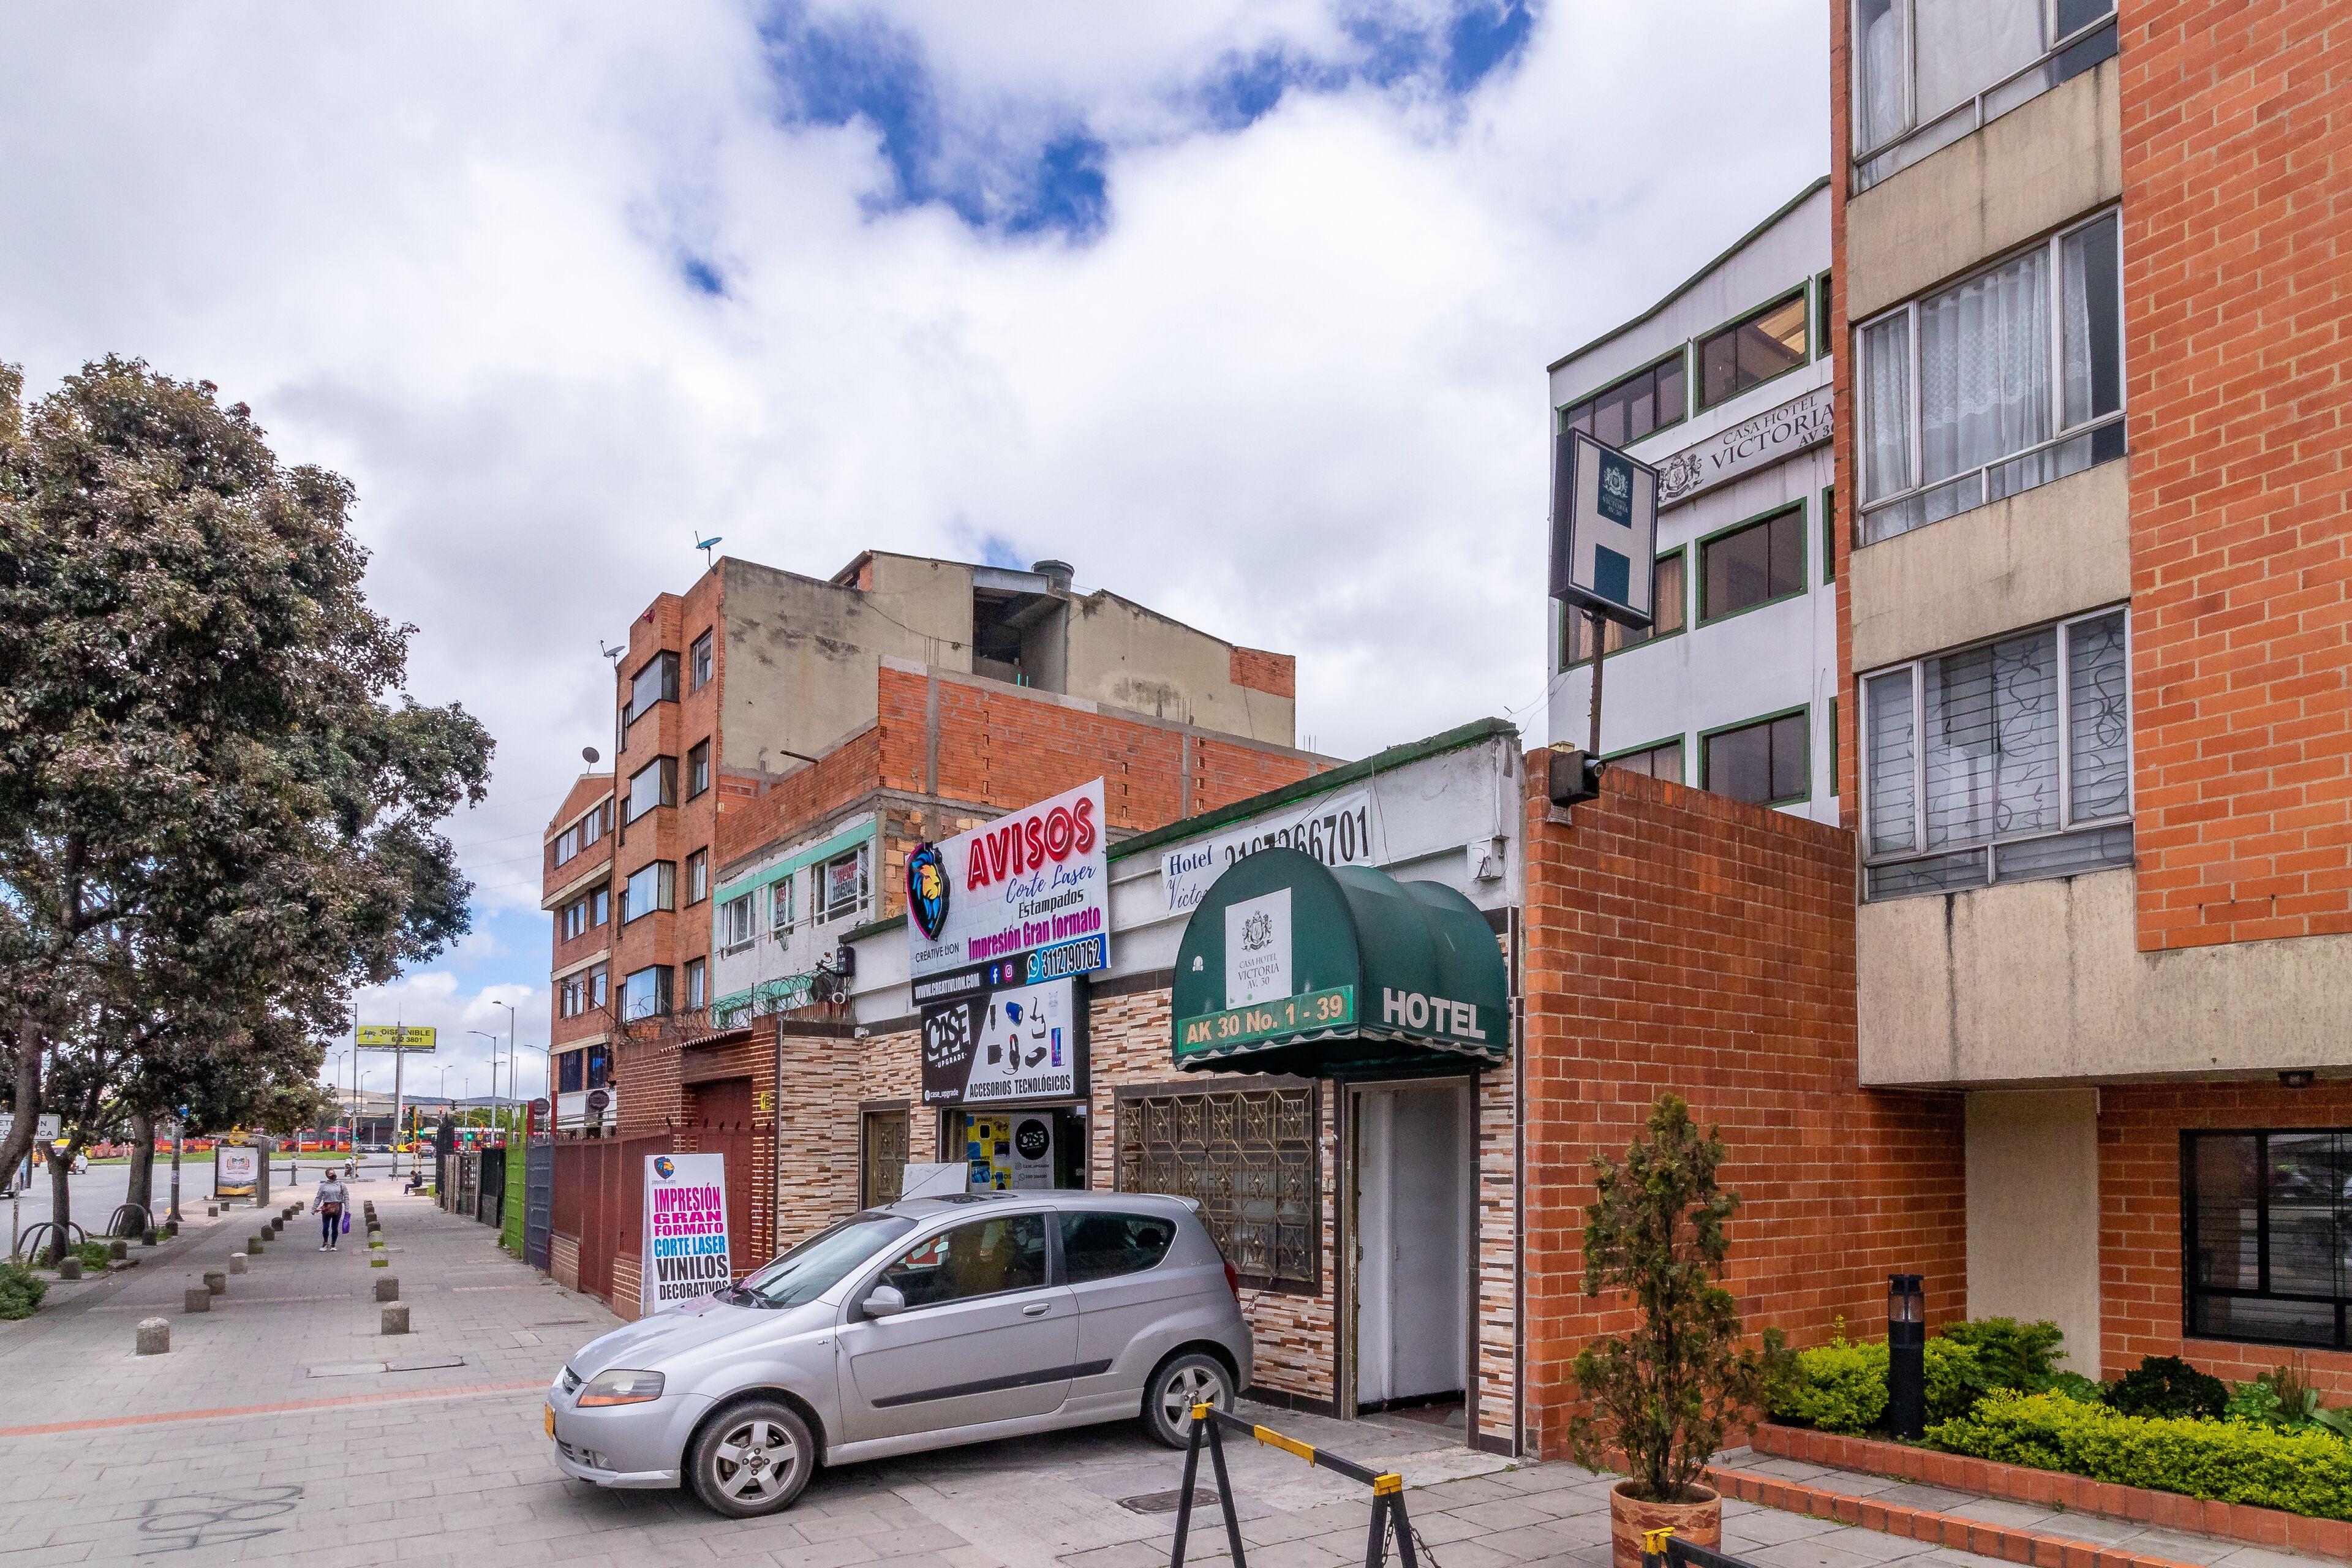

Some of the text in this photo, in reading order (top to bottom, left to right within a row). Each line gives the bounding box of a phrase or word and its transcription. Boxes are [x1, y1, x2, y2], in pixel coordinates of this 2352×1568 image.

[1710, 402, 1834, 469] VICTORIA
[1724, 395, 1817, 445] CASA HOTEL
[1798, 429, 1819, 447] AV
[967, 796, 1097, 892] AVISOS
[1169, 844, 1213, 876] Hotel
[1006, 864, 1096, 903] Corte Laser
[1019, 888, 1084, 919] Estampados
[968, 905, 1101, 961] Impresión Gran formato
[915, 941, 959, 963] CREATIVE LION
[1042, 938, 1101, 978] 3112790762
[1239, 952, 1278, 969] CASA HOTEL
[1238, 962, 1280, 981] VICTORIA
[1247, 979, 1258, 989] AV.
[1186, 1019, 1211, 1046] AK
[1218, 1014, 1240, 1038] 30
[1246, 1009, 1278, 1034] No.
[1285, 1003, 1295, 1026] 1
[1316, 994, 1343, 1022] 39
[1384, 987, 1486, 1040] HOTEL
[970, 1073, 1071, 1098] ACCESORIOS TECNOLÓGICOS
[654, 1182, 722, 1213] IMPRESIÓN
[654, 1210, 722, 1224] GRAN
[654, 1222, 724, 1237] FORMATO
[654, 1235, 726, 1257] CORTE LASER
[656, 1254, 729, 1283] VINILOS
